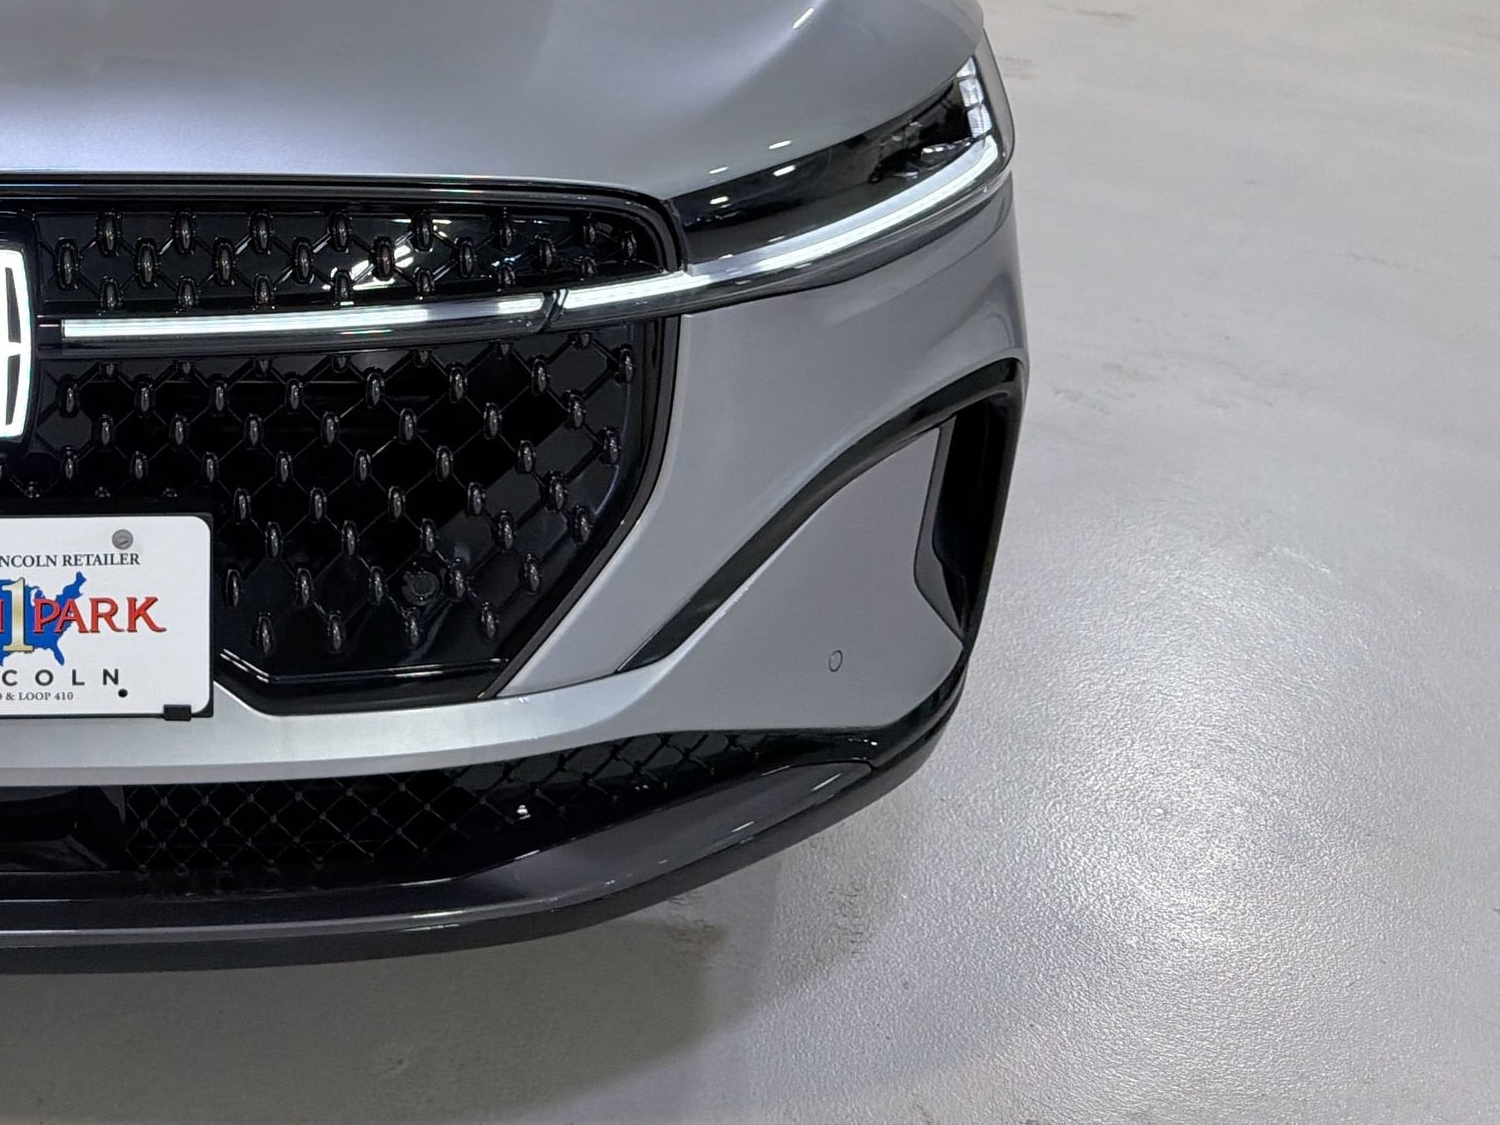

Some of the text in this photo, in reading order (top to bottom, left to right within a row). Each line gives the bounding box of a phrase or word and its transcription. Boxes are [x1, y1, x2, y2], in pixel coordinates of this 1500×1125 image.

[62, 553, 141, 567] RETAILER
[33, 596, 167, 633] PARK
[5, 692, 15, 701] &
[18, 691, 52, 701] LOOP
[54, 691, 74, 701] 410
